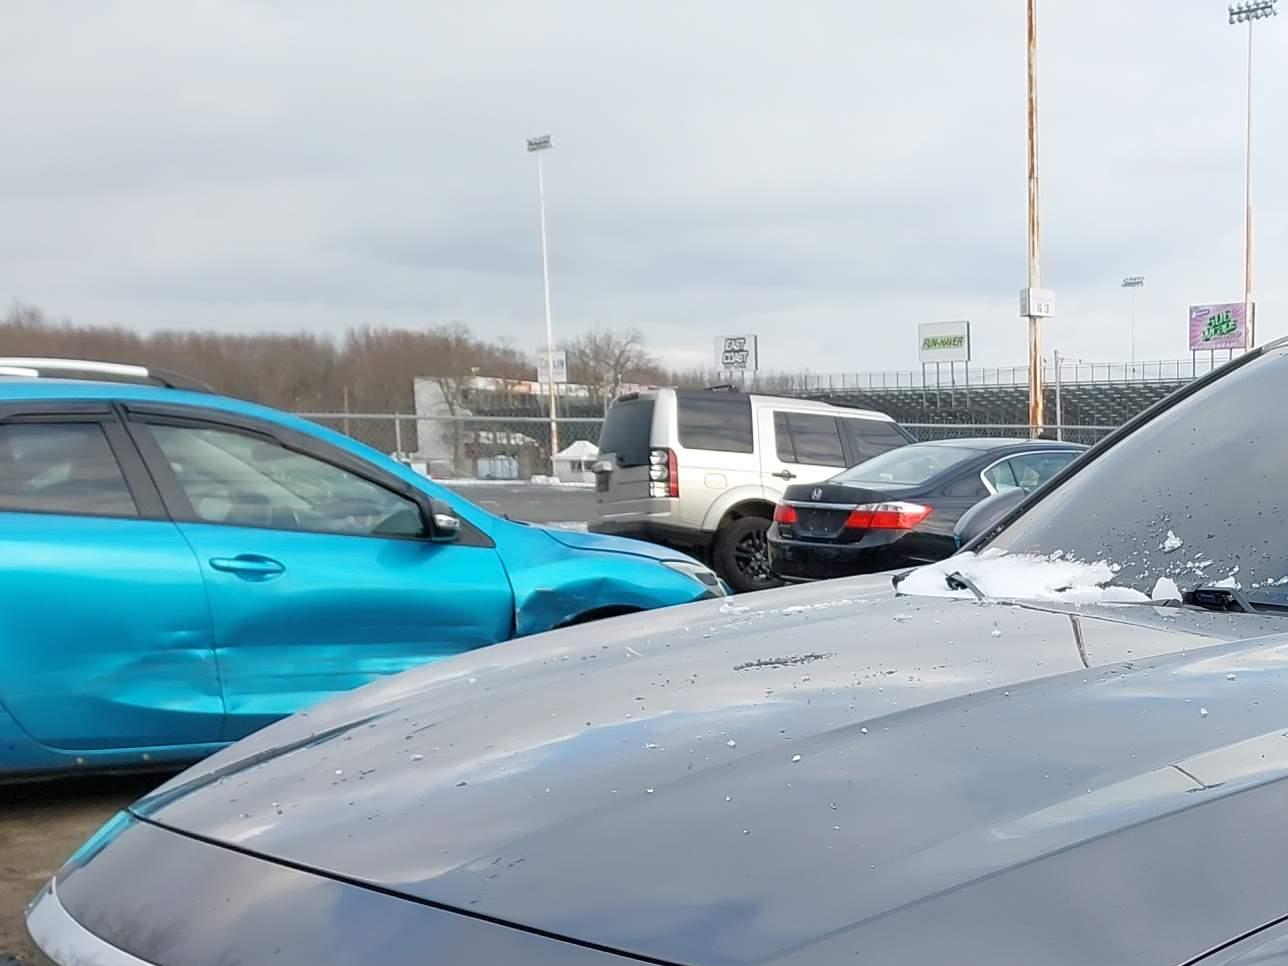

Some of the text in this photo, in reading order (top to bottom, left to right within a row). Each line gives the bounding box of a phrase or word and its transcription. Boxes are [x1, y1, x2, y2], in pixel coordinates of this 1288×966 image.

[724, 337, 746, 351] EAST
[922, 335, 965, 350] FUN-HAVER
[722, 351, 749, 364] COAST
